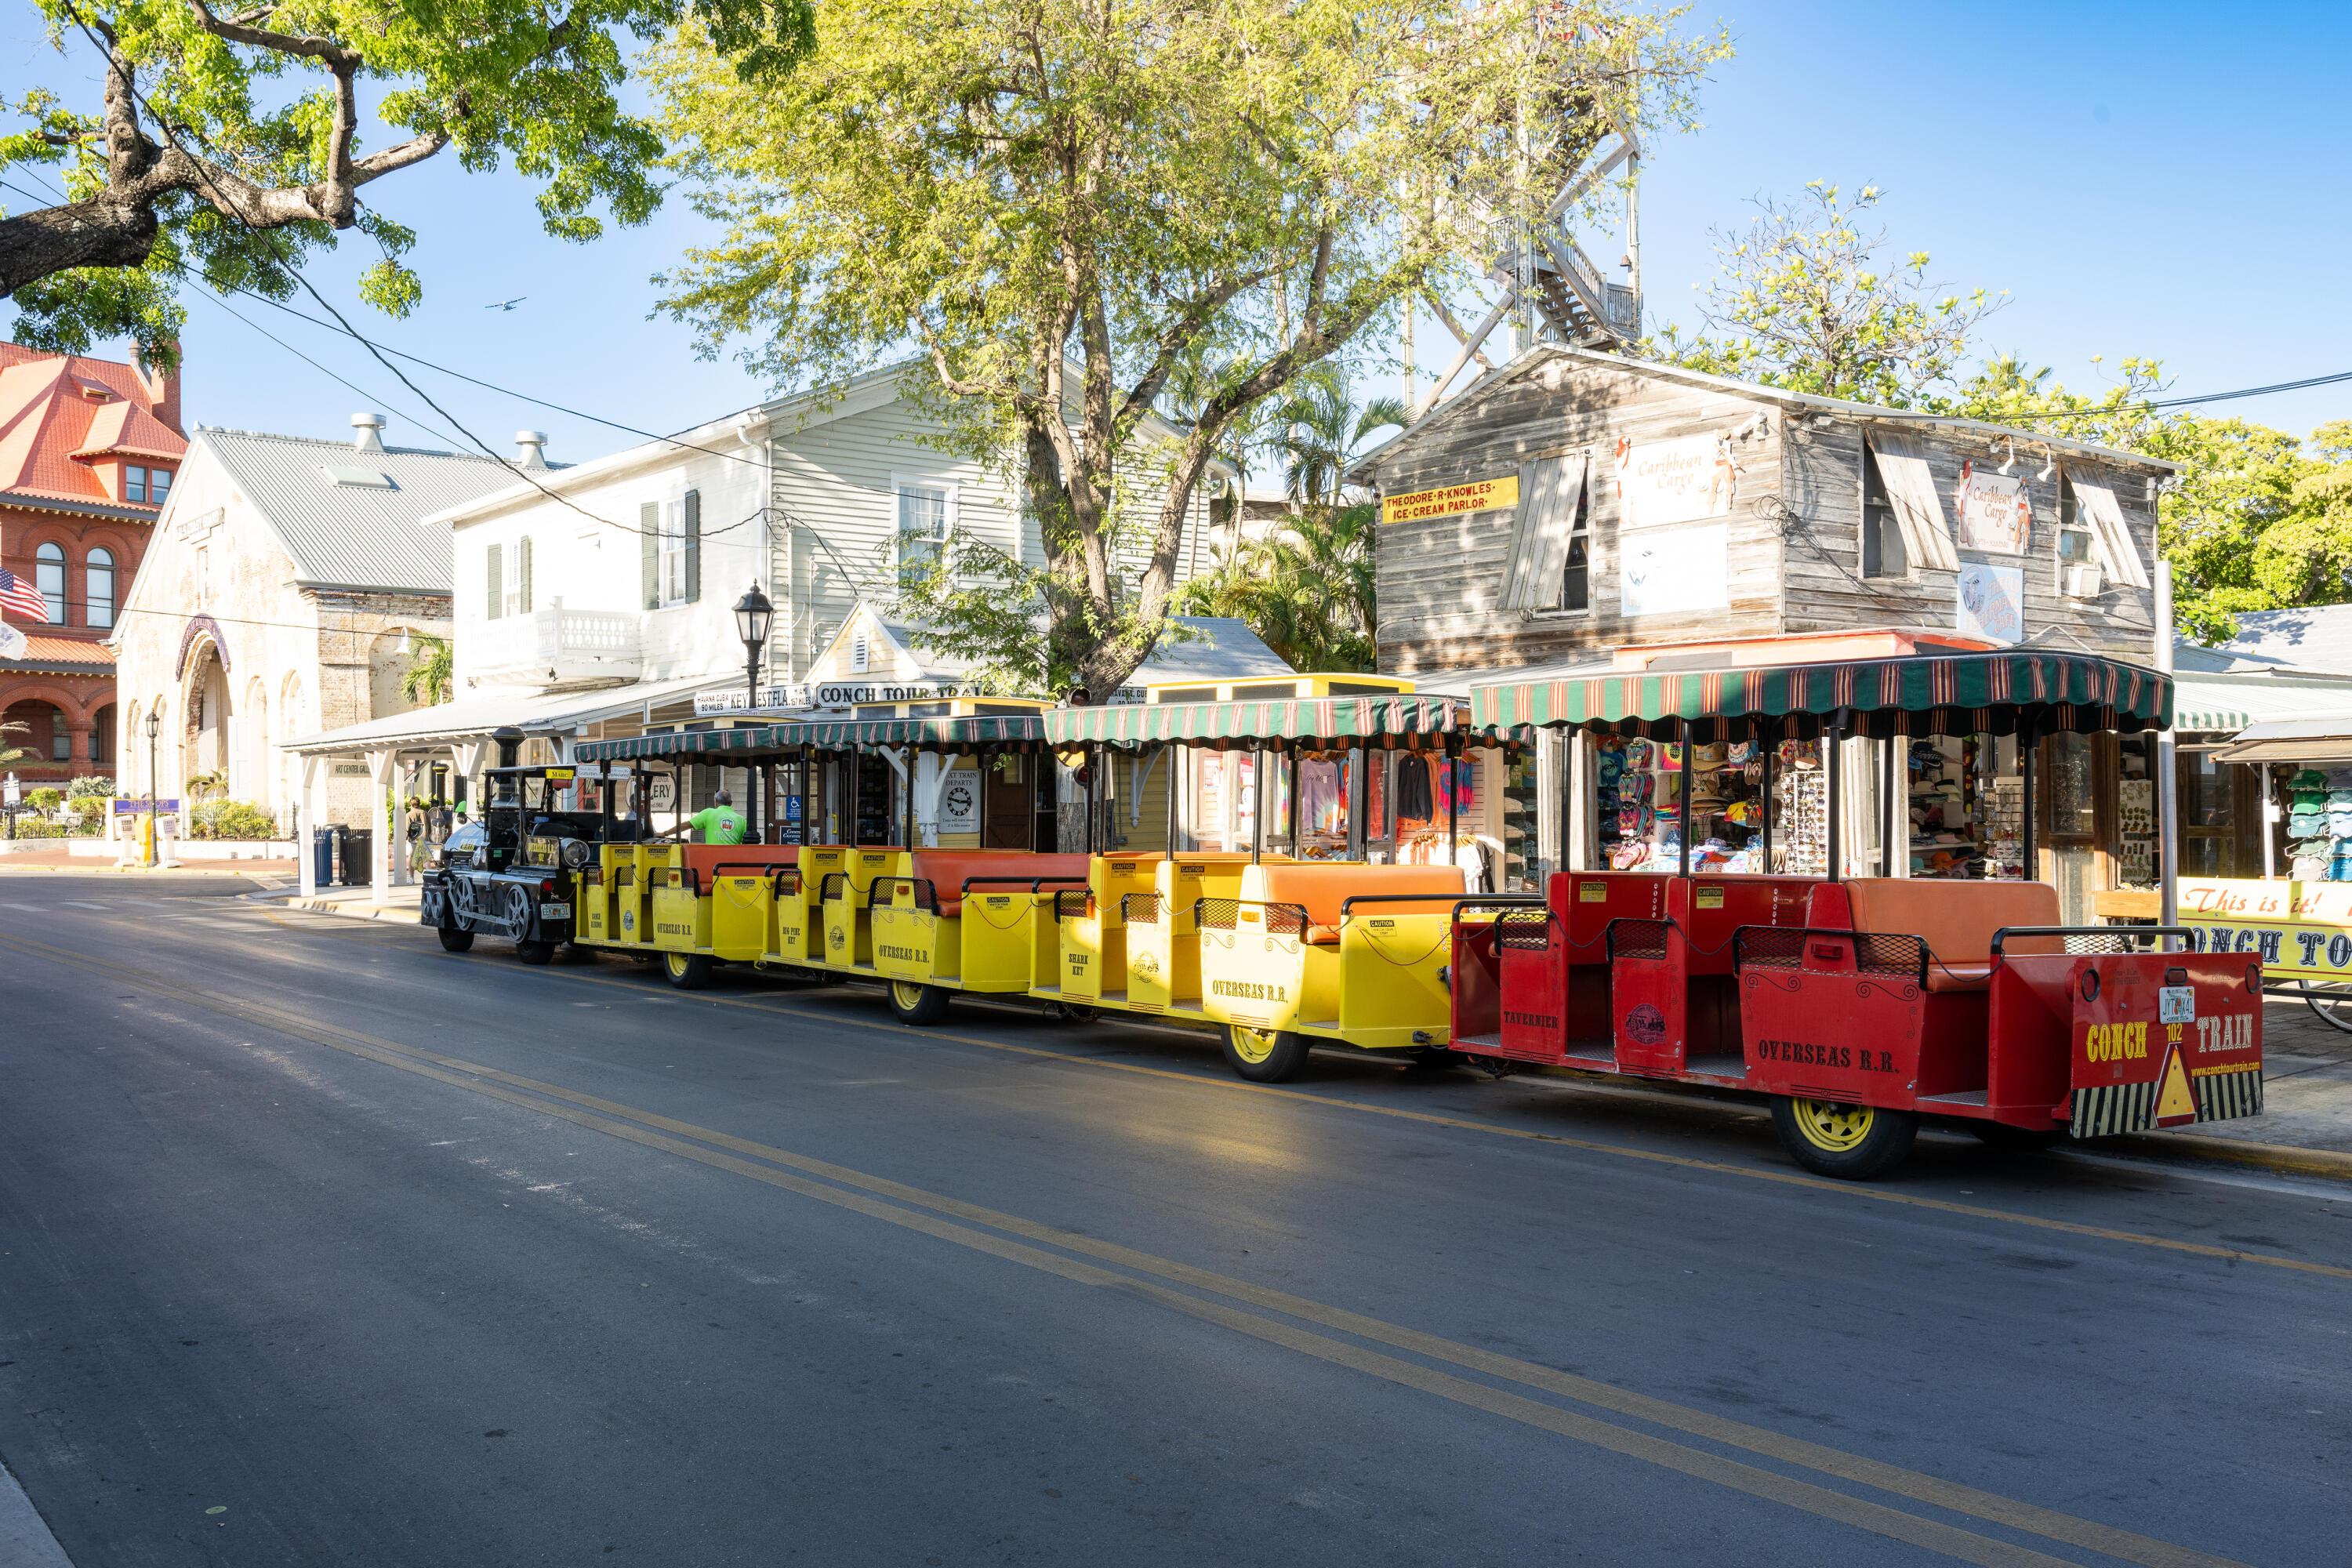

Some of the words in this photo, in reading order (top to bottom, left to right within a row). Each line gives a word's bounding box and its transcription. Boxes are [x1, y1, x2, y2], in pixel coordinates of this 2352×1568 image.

[1638, 452, 1701, 477] Caribbean
[1657, 473, 1693, 495] Cargo
[1973, 485, 2012, 504] Caribbean
[1414, 504, 1444, 517] CREAM
[1985, 503, 2007, 527] Cargo
[1994, 613, 2015, 634] CAFE
[731, 694, 748, 709] KEY
[799, 695, 811, 705] MILES
[821, 688, 876, 702] CONCH
[884, 687, 929, 700] TOUR
[709, 702, 723, 711] MILES
[345, 765, 358, 774] CENTER
[528, 843, 546, 853] OVERSEAS
[2185, 888, 2247, 913] This
[2259, 896, 2278, 912] is
[2290, 891, 2323, 913] it!
[657, 924, 681, 935] OVERSEAS
[682, 925, 692, 935] R.R.
[879, 945, 913, 960] OVERSEAS
[916, 949, 930, 964] R.R.
[1069, 953, 1088, 965] SHARK
[1073, 966, 1083, 976] KEY
[1213, 979, 1264, 1000] OVERSEAS
[1267, 985, 1288, 1004] R.R.
[1504, 1011, 1558, 1029] TAVERNIER
[2086, 1022, 2147, 1062] CONCH
[2198, 1014, 2252, 1053] TRAIN
[2166, 1023, 2183, 1041] 102
[1759, 1040, 1851, 1068] OVERSEAS
[1859, 1049, 1900, 1074] R.R.
[2191, 1062, 2260, 1076] www.conchtourtrain.com
